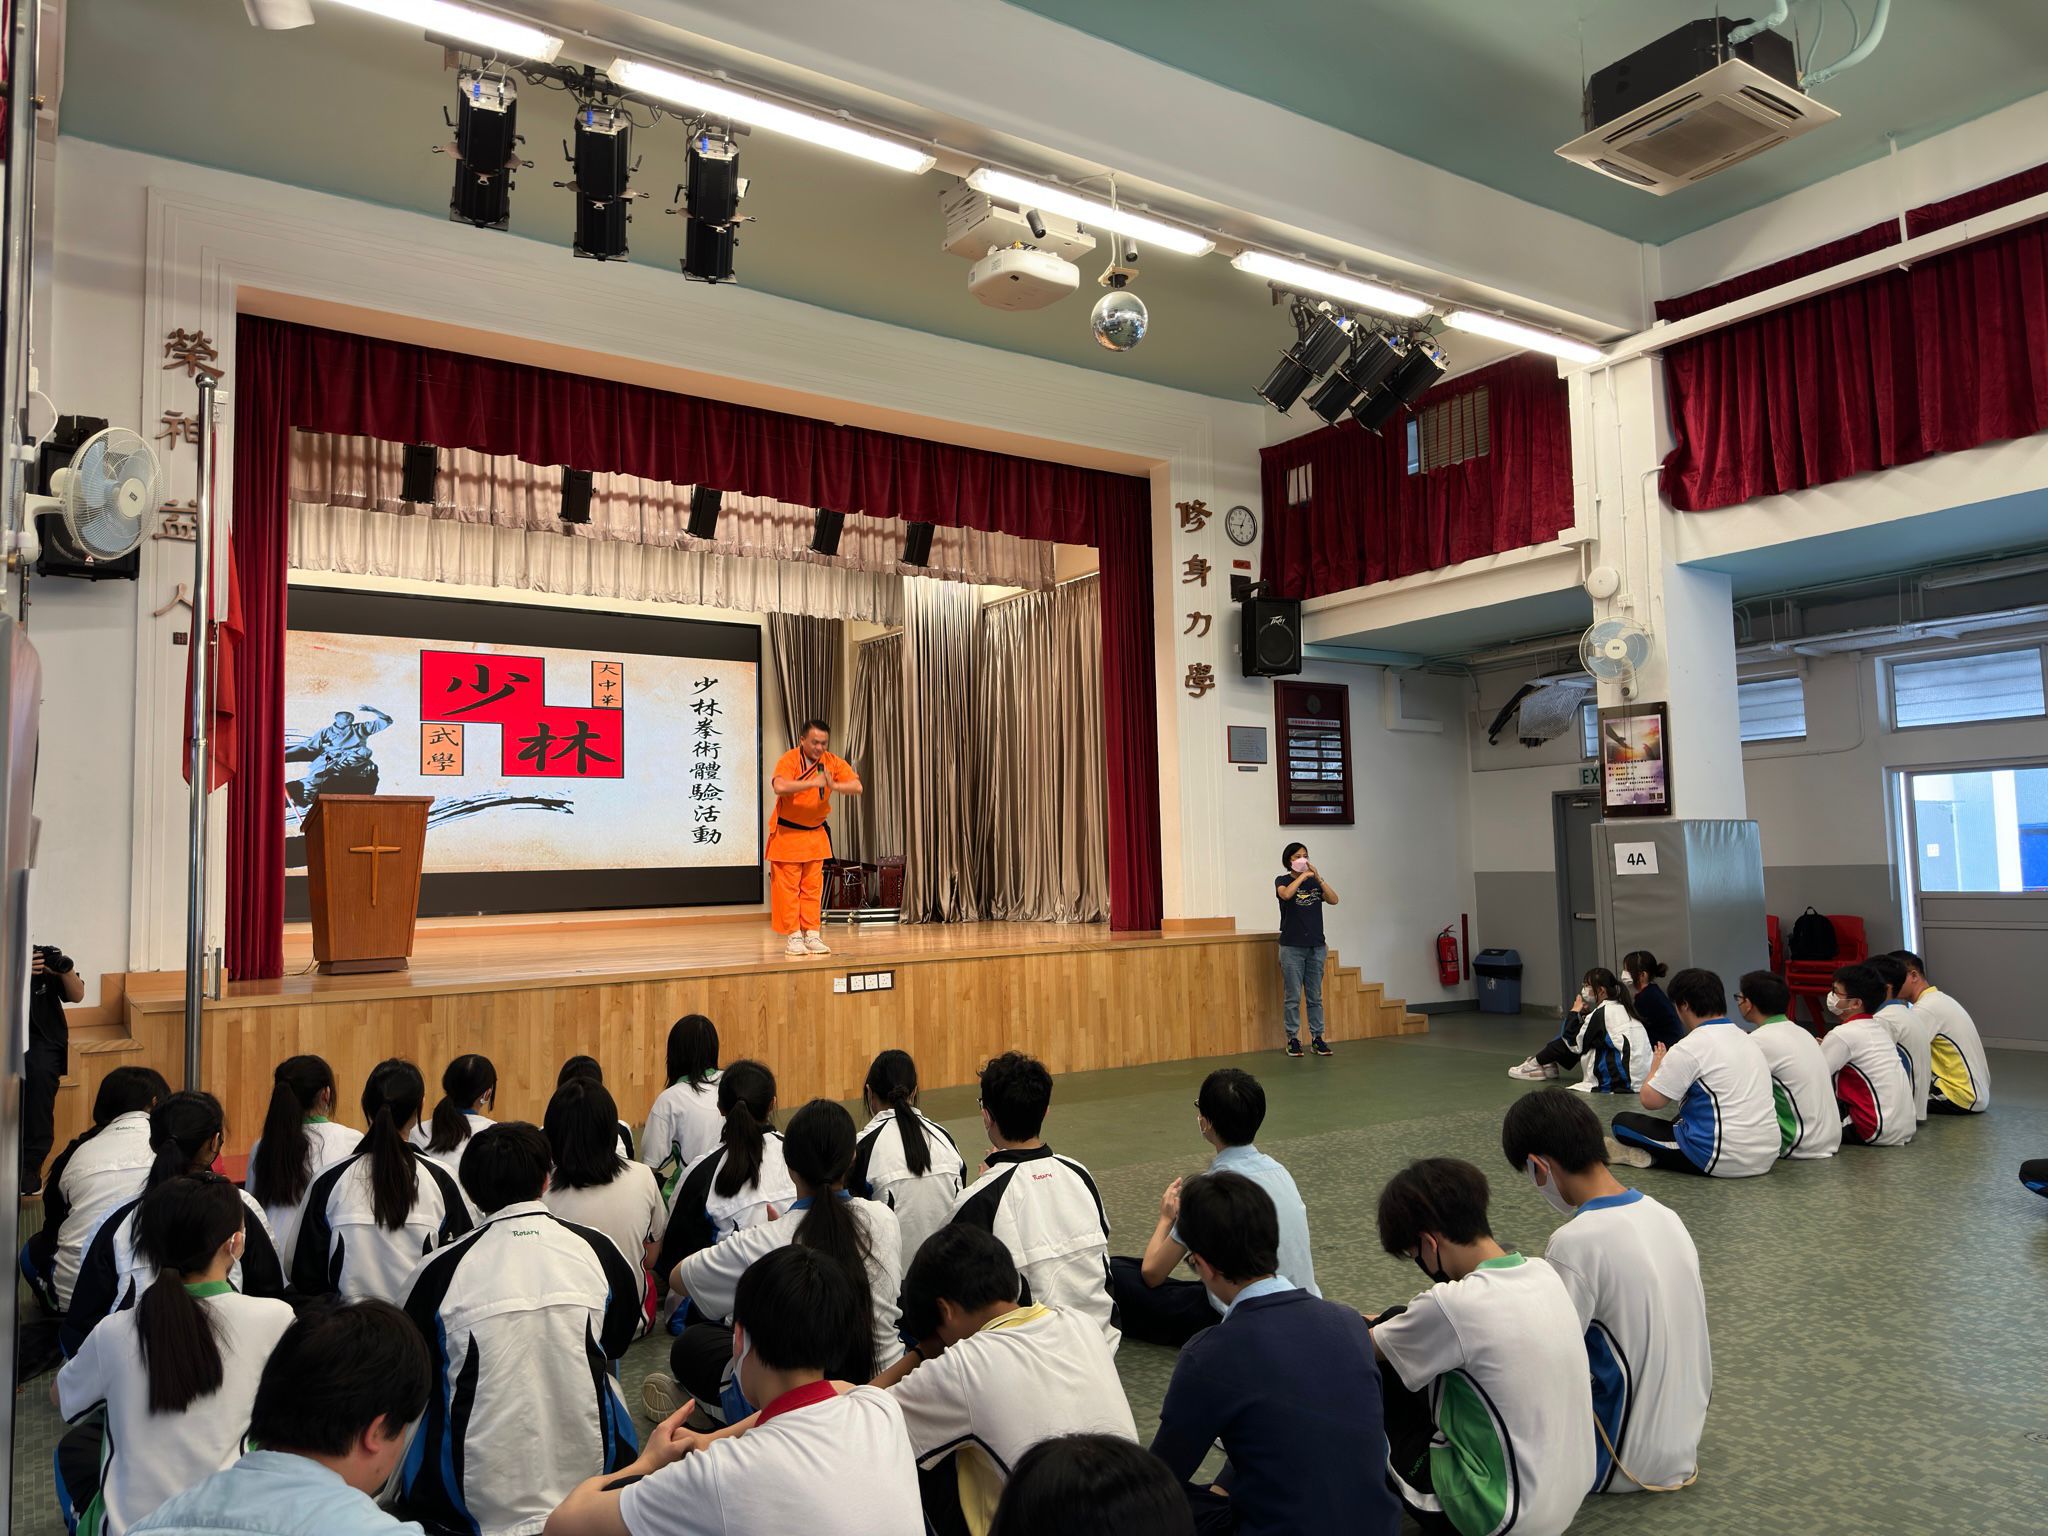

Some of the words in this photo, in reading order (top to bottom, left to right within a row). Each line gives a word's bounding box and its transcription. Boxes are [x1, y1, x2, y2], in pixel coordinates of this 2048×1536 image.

[1175, 499, 1216, 698] 修身力學
[598, 664, 620, 706] 大中華
[427, 727, 459, 772] 武學
[688, 676, 725, 845] 少林拳術體驗活動
[1582, 768, 1599, 785] EX
[1627, 853, 1647, 866] 4A
